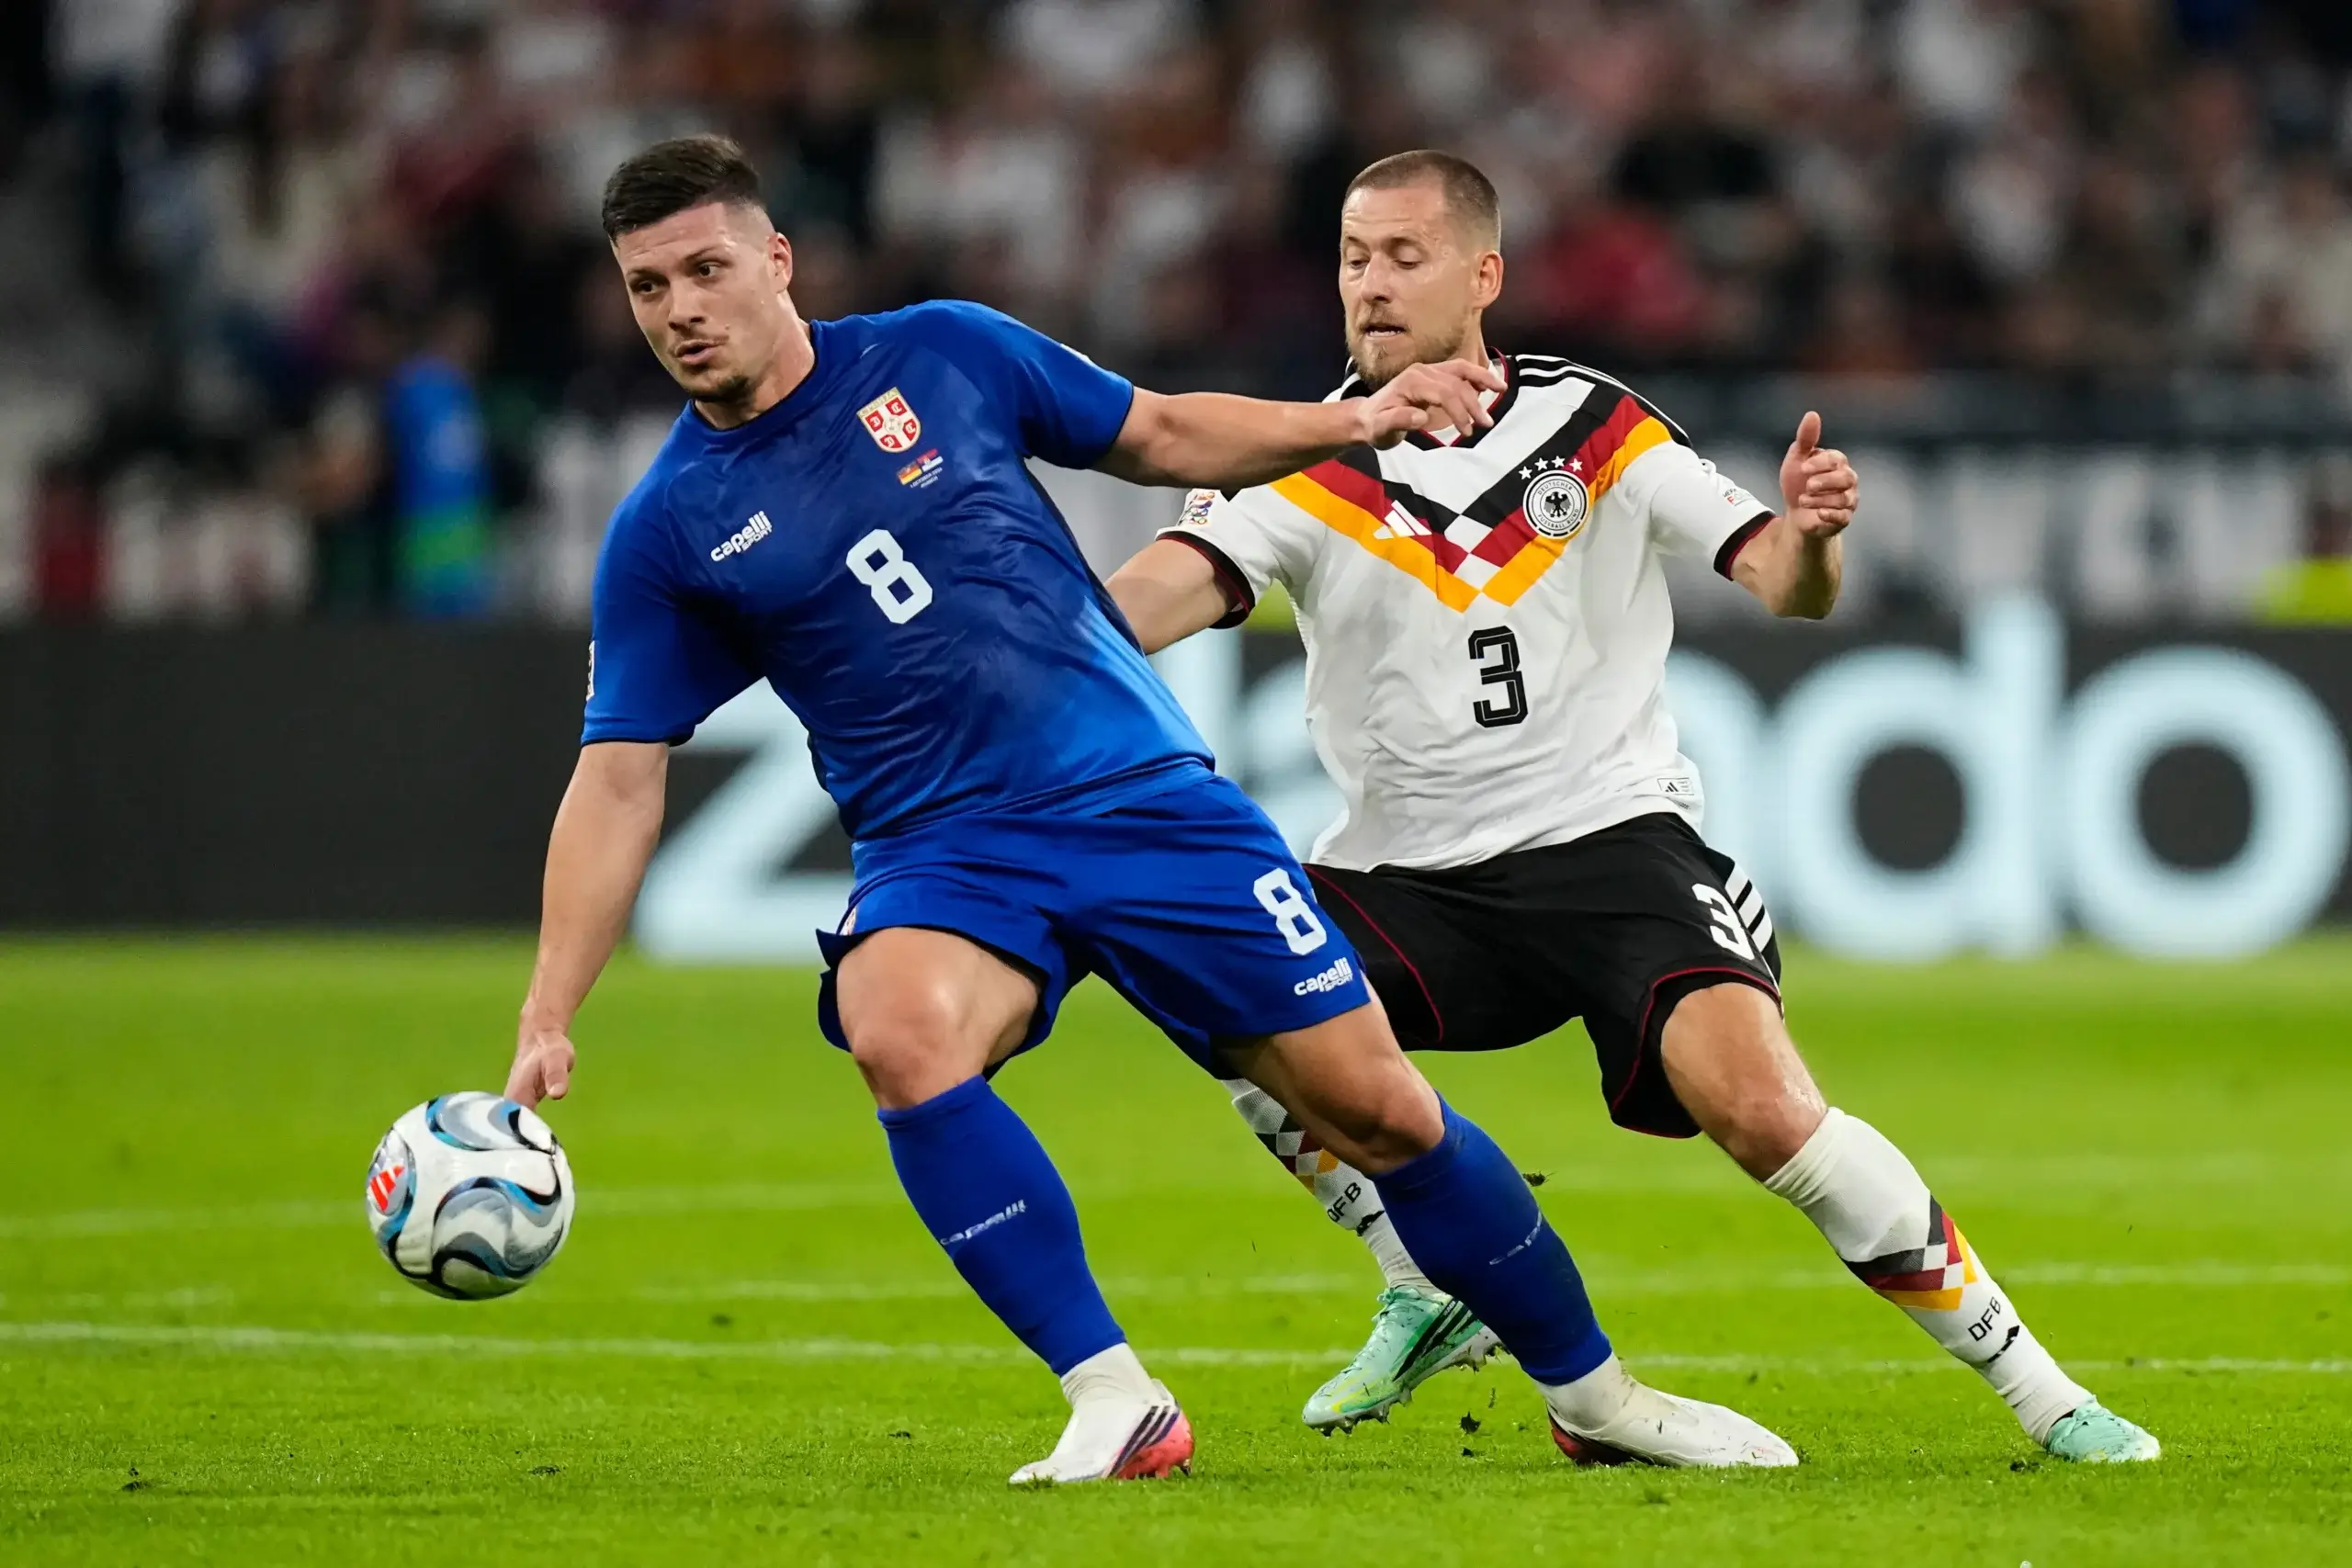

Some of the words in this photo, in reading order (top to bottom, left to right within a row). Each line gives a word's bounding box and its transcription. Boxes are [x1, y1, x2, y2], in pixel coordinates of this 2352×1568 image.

[1538, 480, 1573, 495] DEUTSCHER
[710, 511, 772, 561] capelli
[845, 528, 933, 625] 8
[1467, 625, 1529, 728] 3
[1253, 867, 1327, 955] 8
[1691, 883, 1755, 961] 3
[1294, 956, 1352, 996] capelli
[1327, 1182, 1362, 1223] DFB
[1968, 1296, 2001, 1341] DFB
